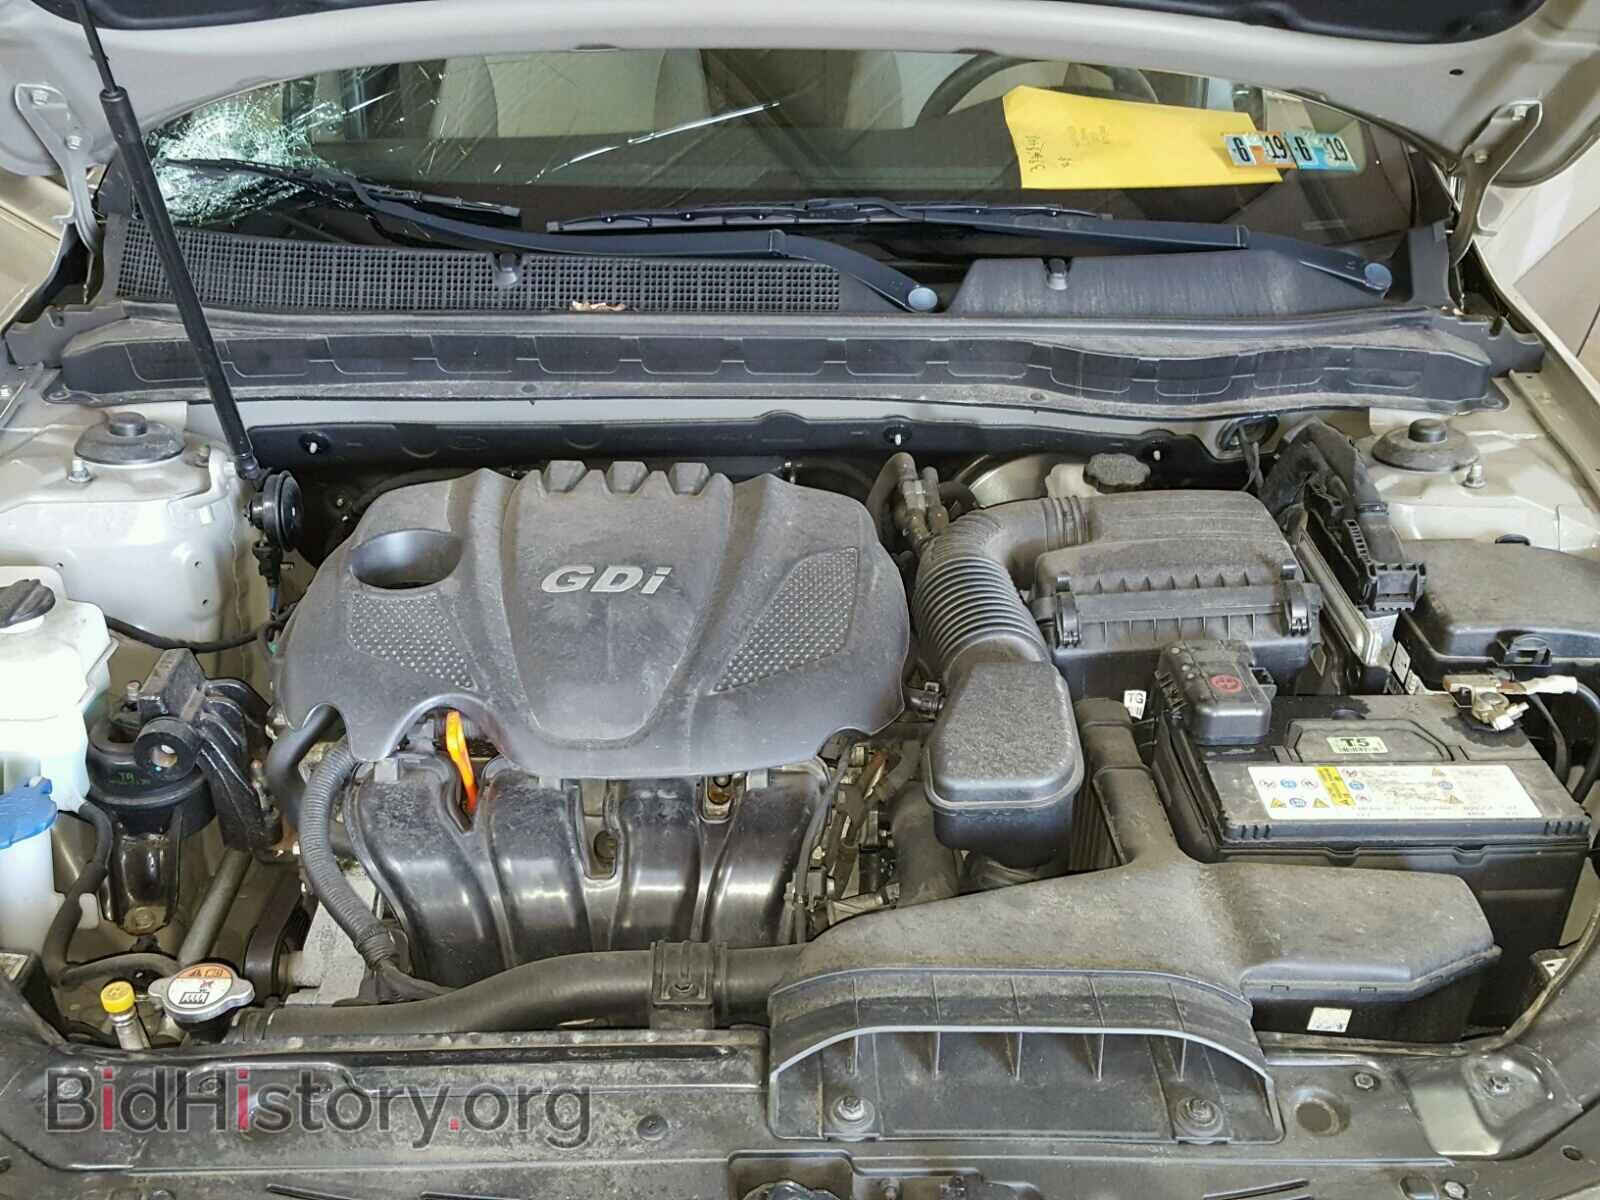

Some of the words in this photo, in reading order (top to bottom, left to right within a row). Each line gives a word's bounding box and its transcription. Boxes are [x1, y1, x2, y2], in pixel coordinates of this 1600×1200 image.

[1232, 136, 1251, 162] 6
[1264, 134, 1288, 159] 19
[1294, 136, 1312, 161] 6
[1325, 137, 1348, 161] 19
[541, 565, 672, 595] GDi
